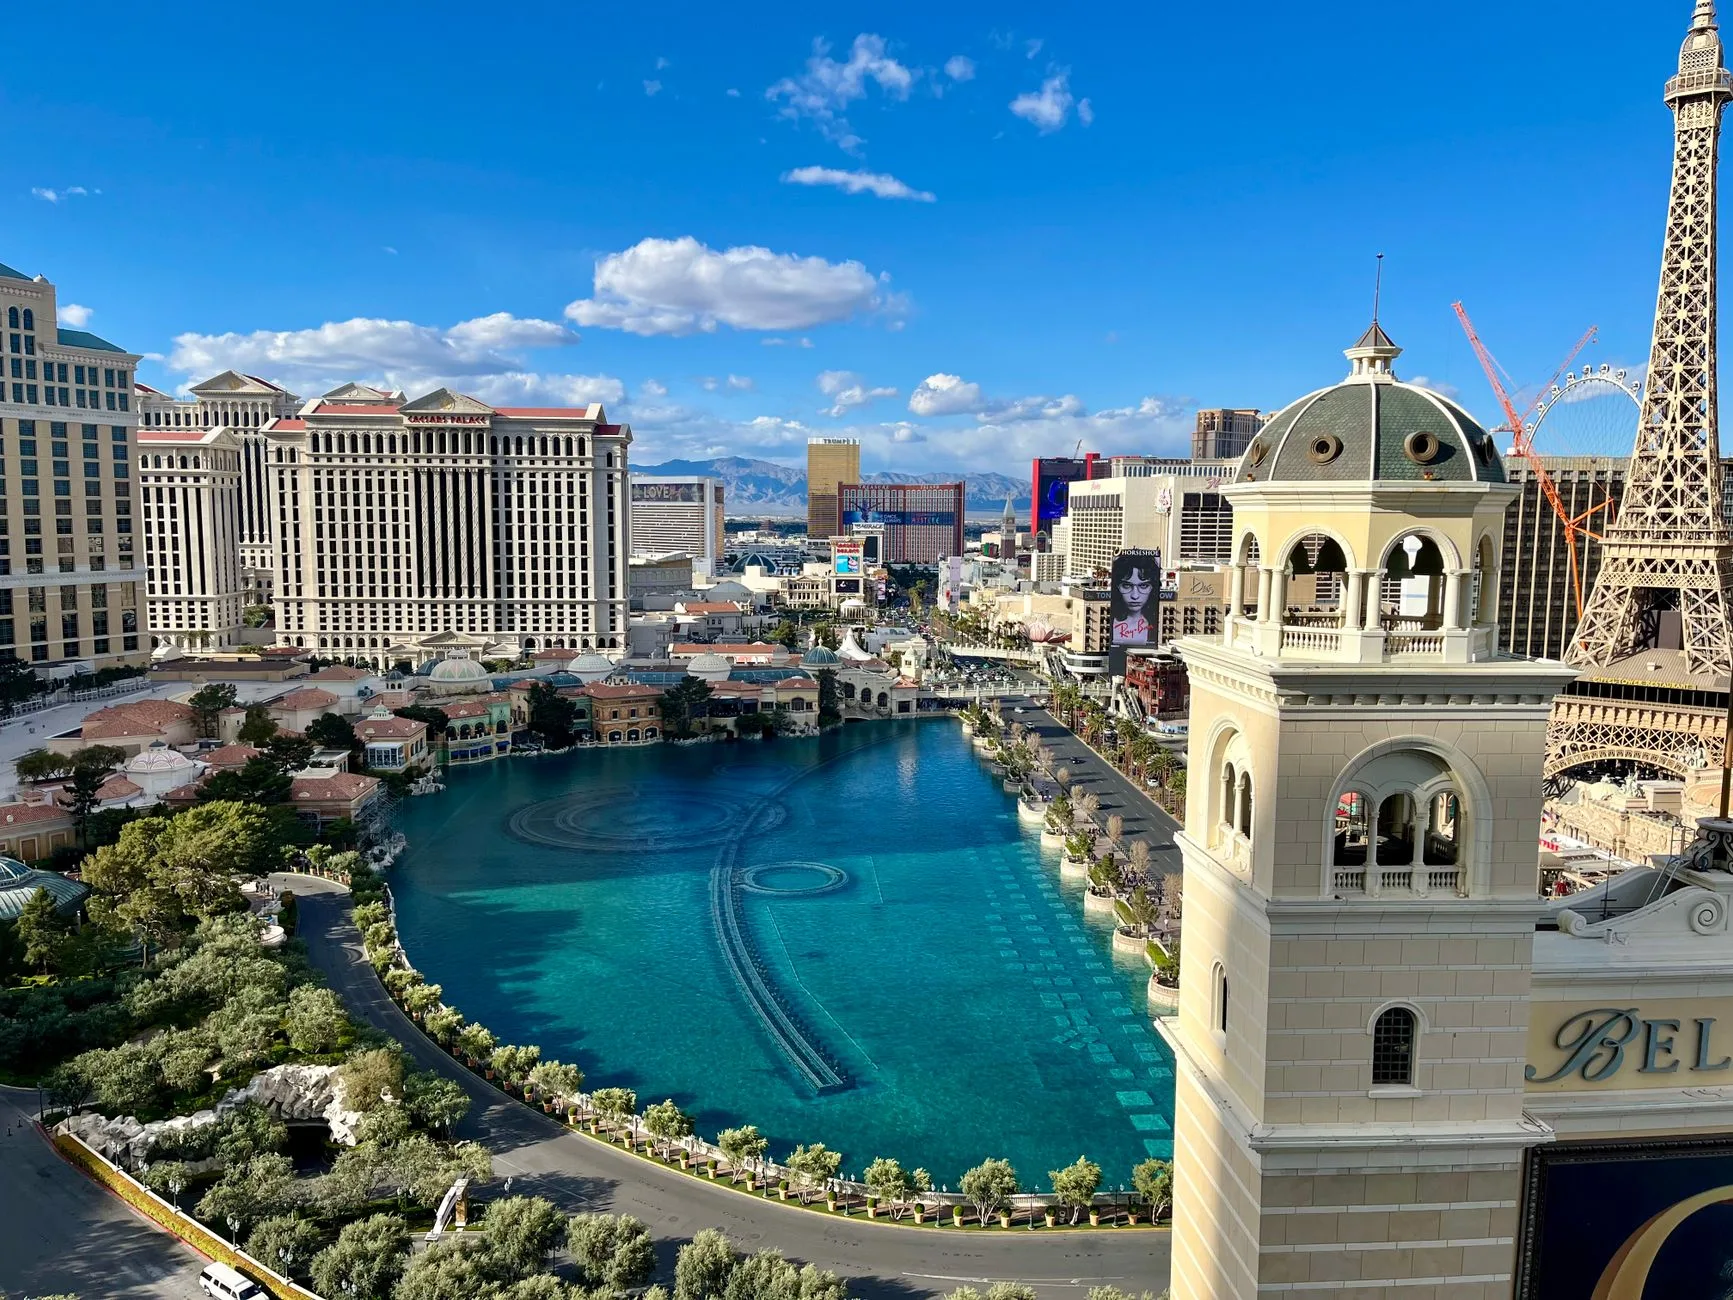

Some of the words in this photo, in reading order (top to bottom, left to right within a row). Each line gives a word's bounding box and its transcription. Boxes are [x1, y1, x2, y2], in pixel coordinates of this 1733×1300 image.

[407, 415, 448, 424] CAESARS
[450, 416, 487, 424] PALACE
[643, 486, 670, 499] LOVE
[1618, 678, 1643, 686] TOWER
[1644, 681, 1692, 690] RESTAURANT
